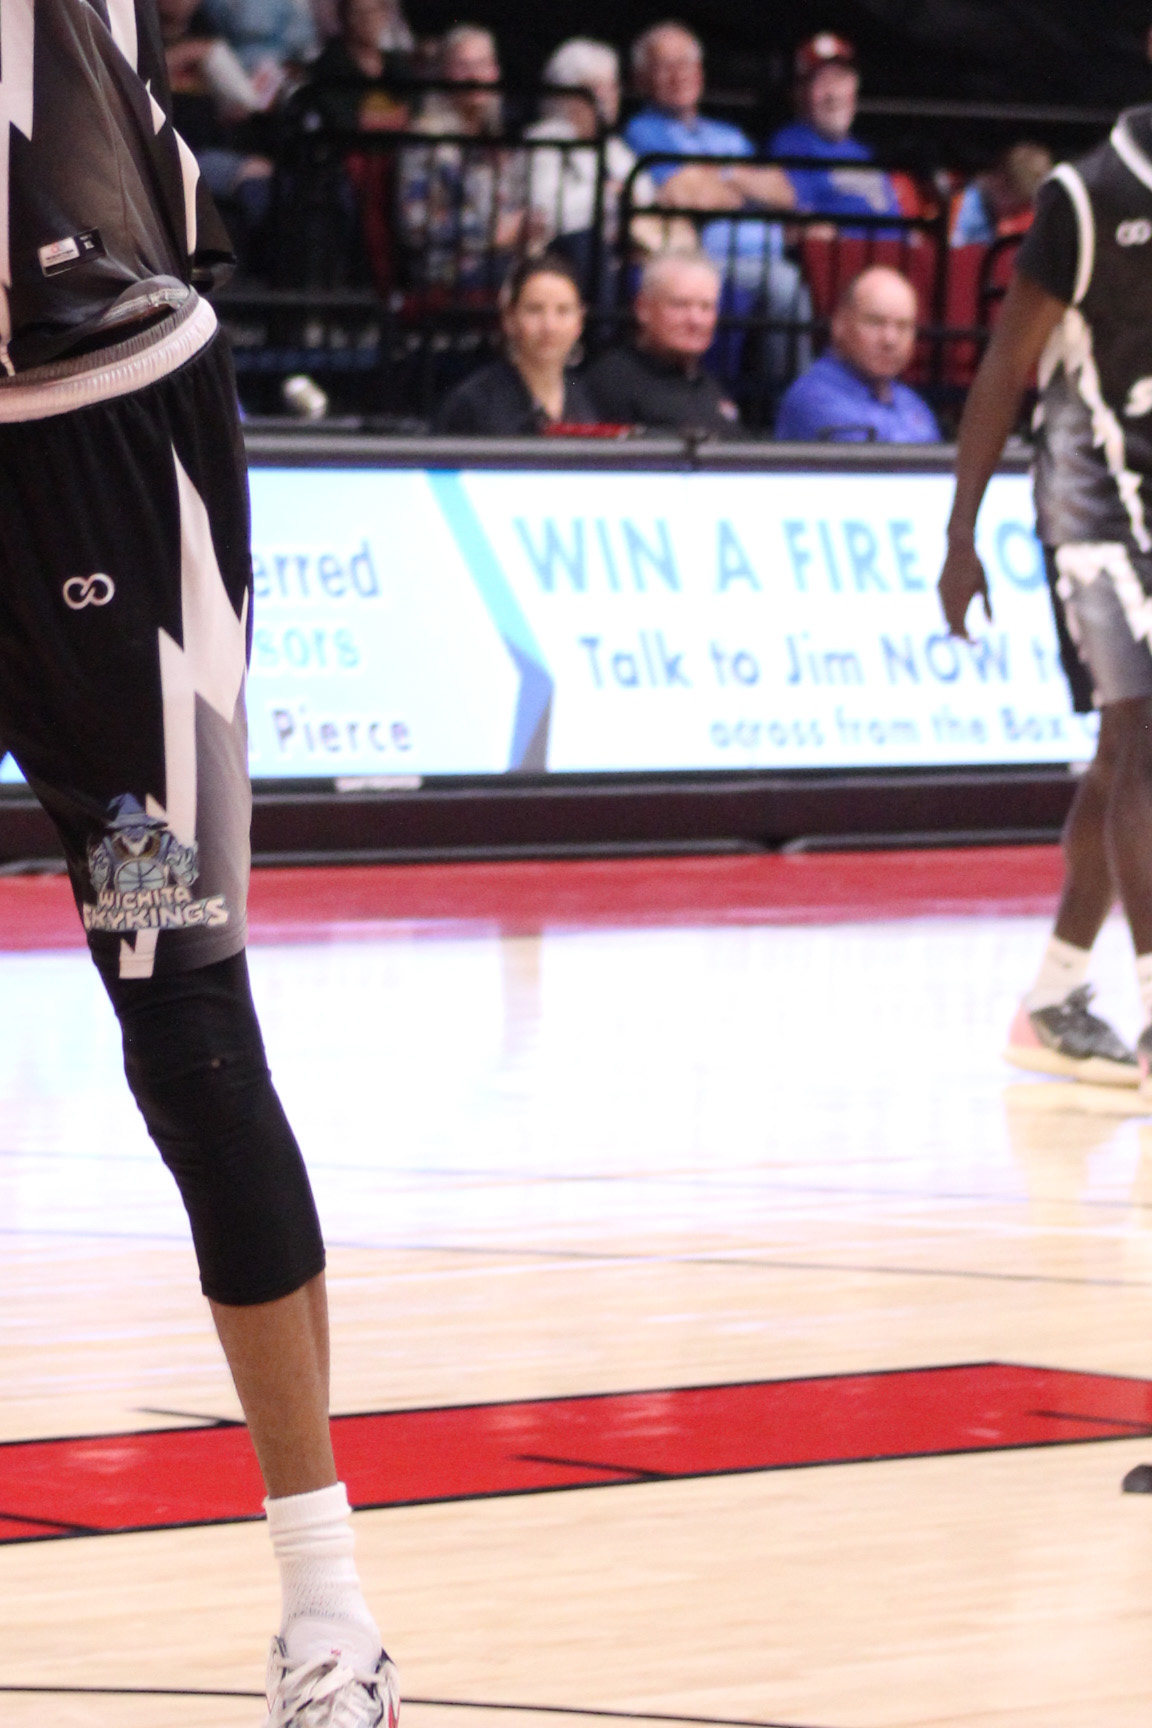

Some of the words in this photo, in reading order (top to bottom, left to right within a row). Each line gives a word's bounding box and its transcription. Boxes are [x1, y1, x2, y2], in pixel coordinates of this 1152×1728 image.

[512, 516, 682, 594] WIN
[716, 516, 762, 594] A
[782, 516, 928, 594] FIRE
[578, 630, 693, 689] Talk
[708, 638, 761, 687] to
[784, 629, 865, 686] Jim
[878, 630, 1012, 685] NOW
[272, 705, 412, 754] Pierce
[709, 718, 825, 749] across
[834, 703, 921, 747] from
[931, 703, 990, 745] the
[998, 704, 1069, 743] Box
[99, 885, 193, 909] WICHITA
